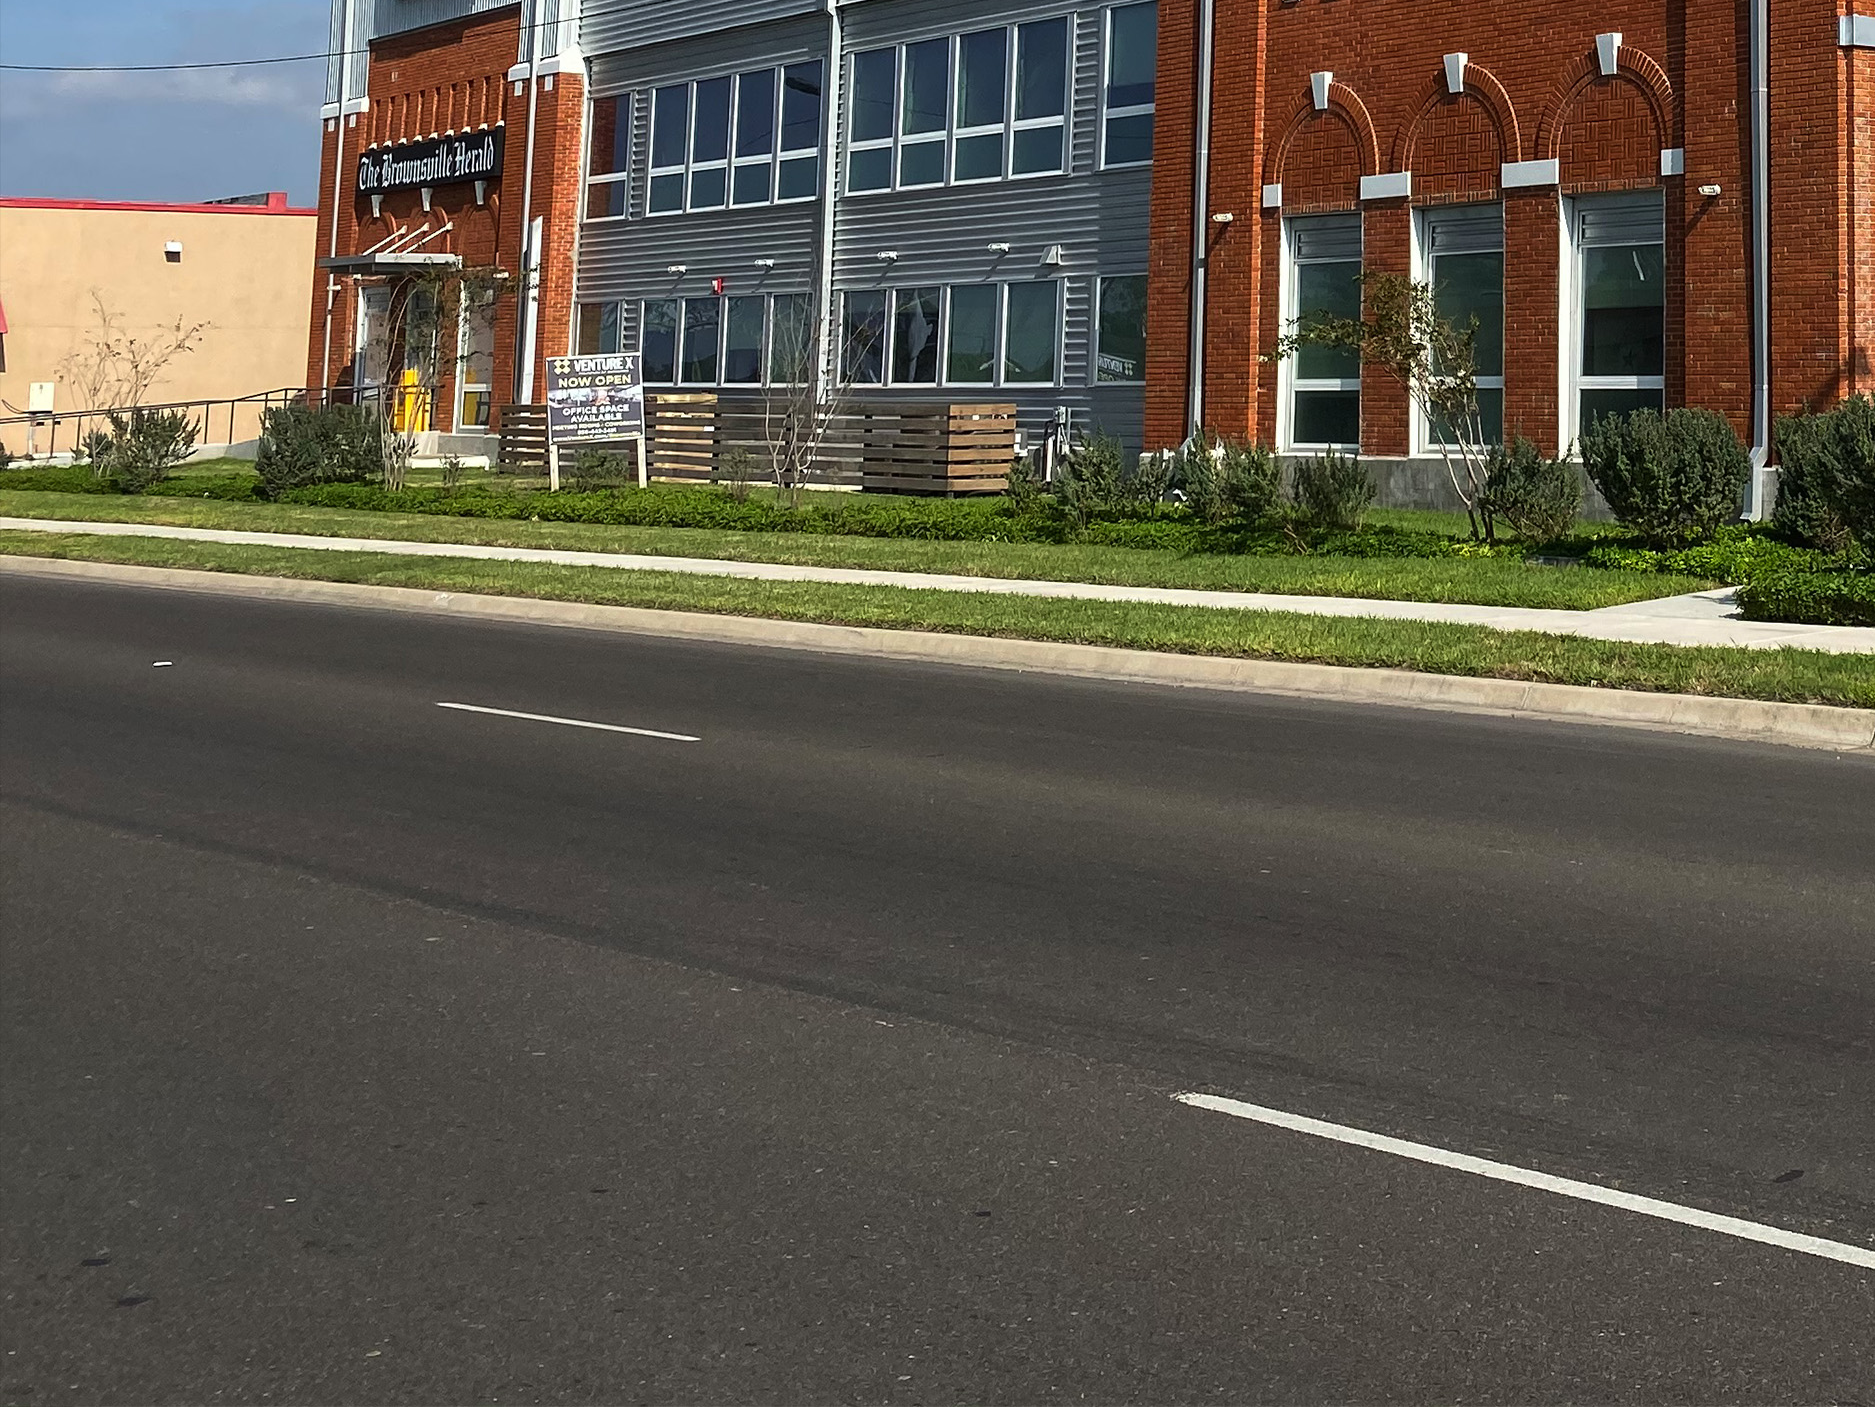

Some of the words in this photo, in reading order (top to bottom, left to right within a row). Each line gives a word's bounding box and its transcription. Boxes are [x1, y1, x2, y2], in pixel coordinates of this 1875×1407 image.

[359, 155, 380, 190] The
[381, 143, 453, 187] Brownsville
[454, 135, 494, 176] Herald
[573, 357, 624, 372] VENTURE
[625, 356, 634, 370] X
[558, 377, 591, 388] NOW
[595, 374, 632, 386] OPEN
[562, 406, 598, 416] OFFICE
[599, 404, 630, 414] SPACE
[570, 412, 623, 423] AVAILABLE
